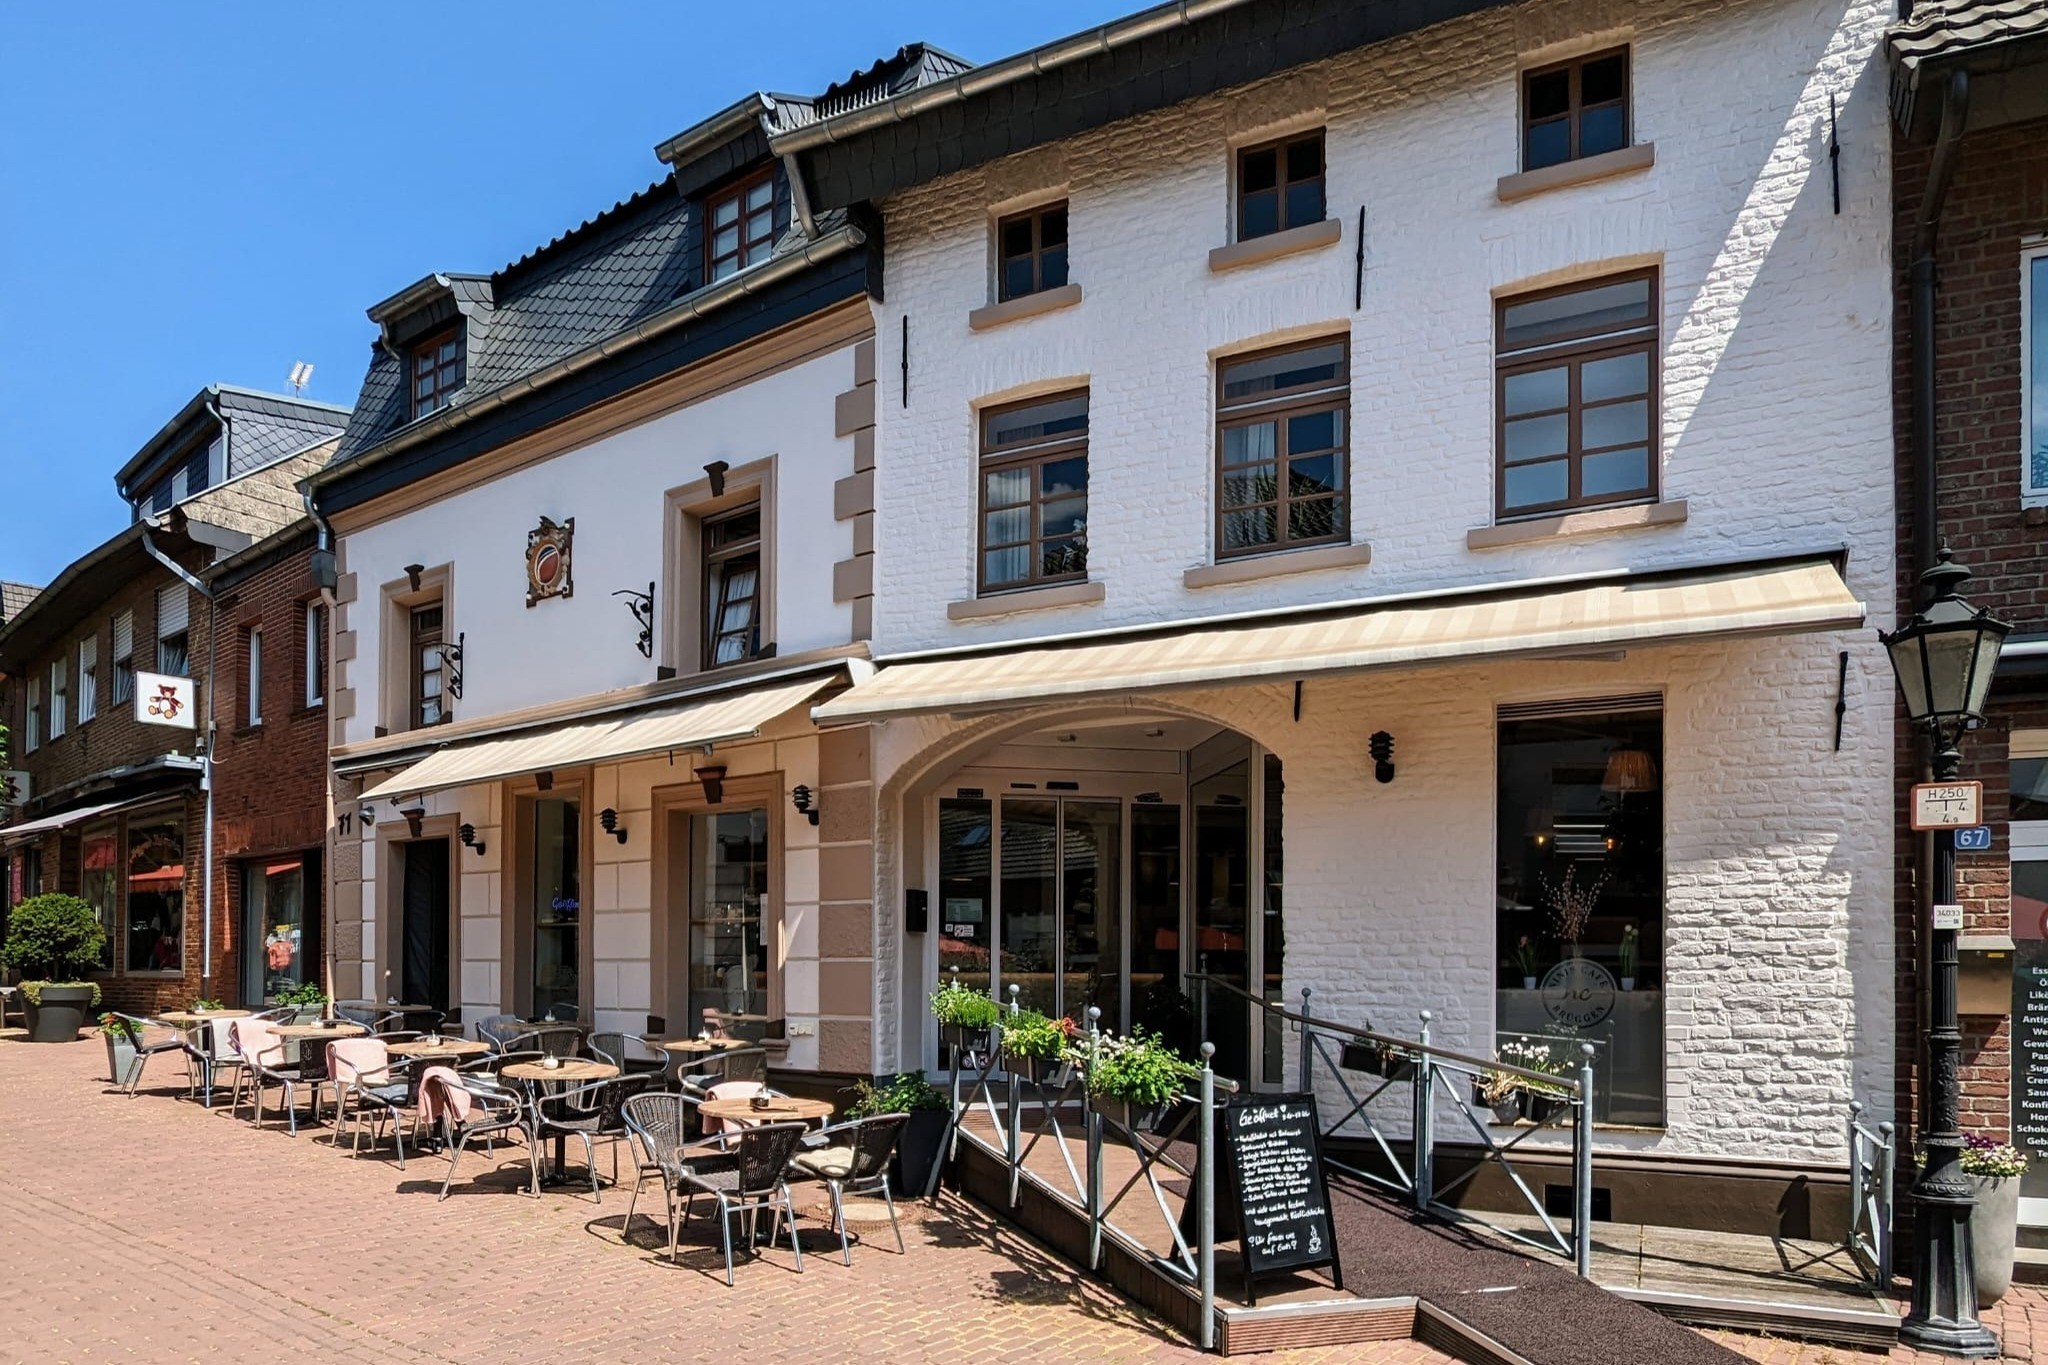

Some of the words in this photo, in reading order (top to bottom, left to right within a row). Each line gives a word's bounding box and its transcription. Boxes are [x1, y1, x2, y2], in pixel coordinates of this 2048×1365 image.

[337, 812, 352, 836] 11
[1960, 829, 1985, 846] 67
[2039, 978, 2048, 987] Ö
[2022, 1015, 2048, 1025] Antip
[2032, 1028, 2048, 1036] We
[2031, 1052, 2048, 1060] Pas
[1240, 1108, 1279, 1127] Geöffnet
[2036, 1150, 2048, 1158] Te
[1262, 1244, 1275, 1256] auf
